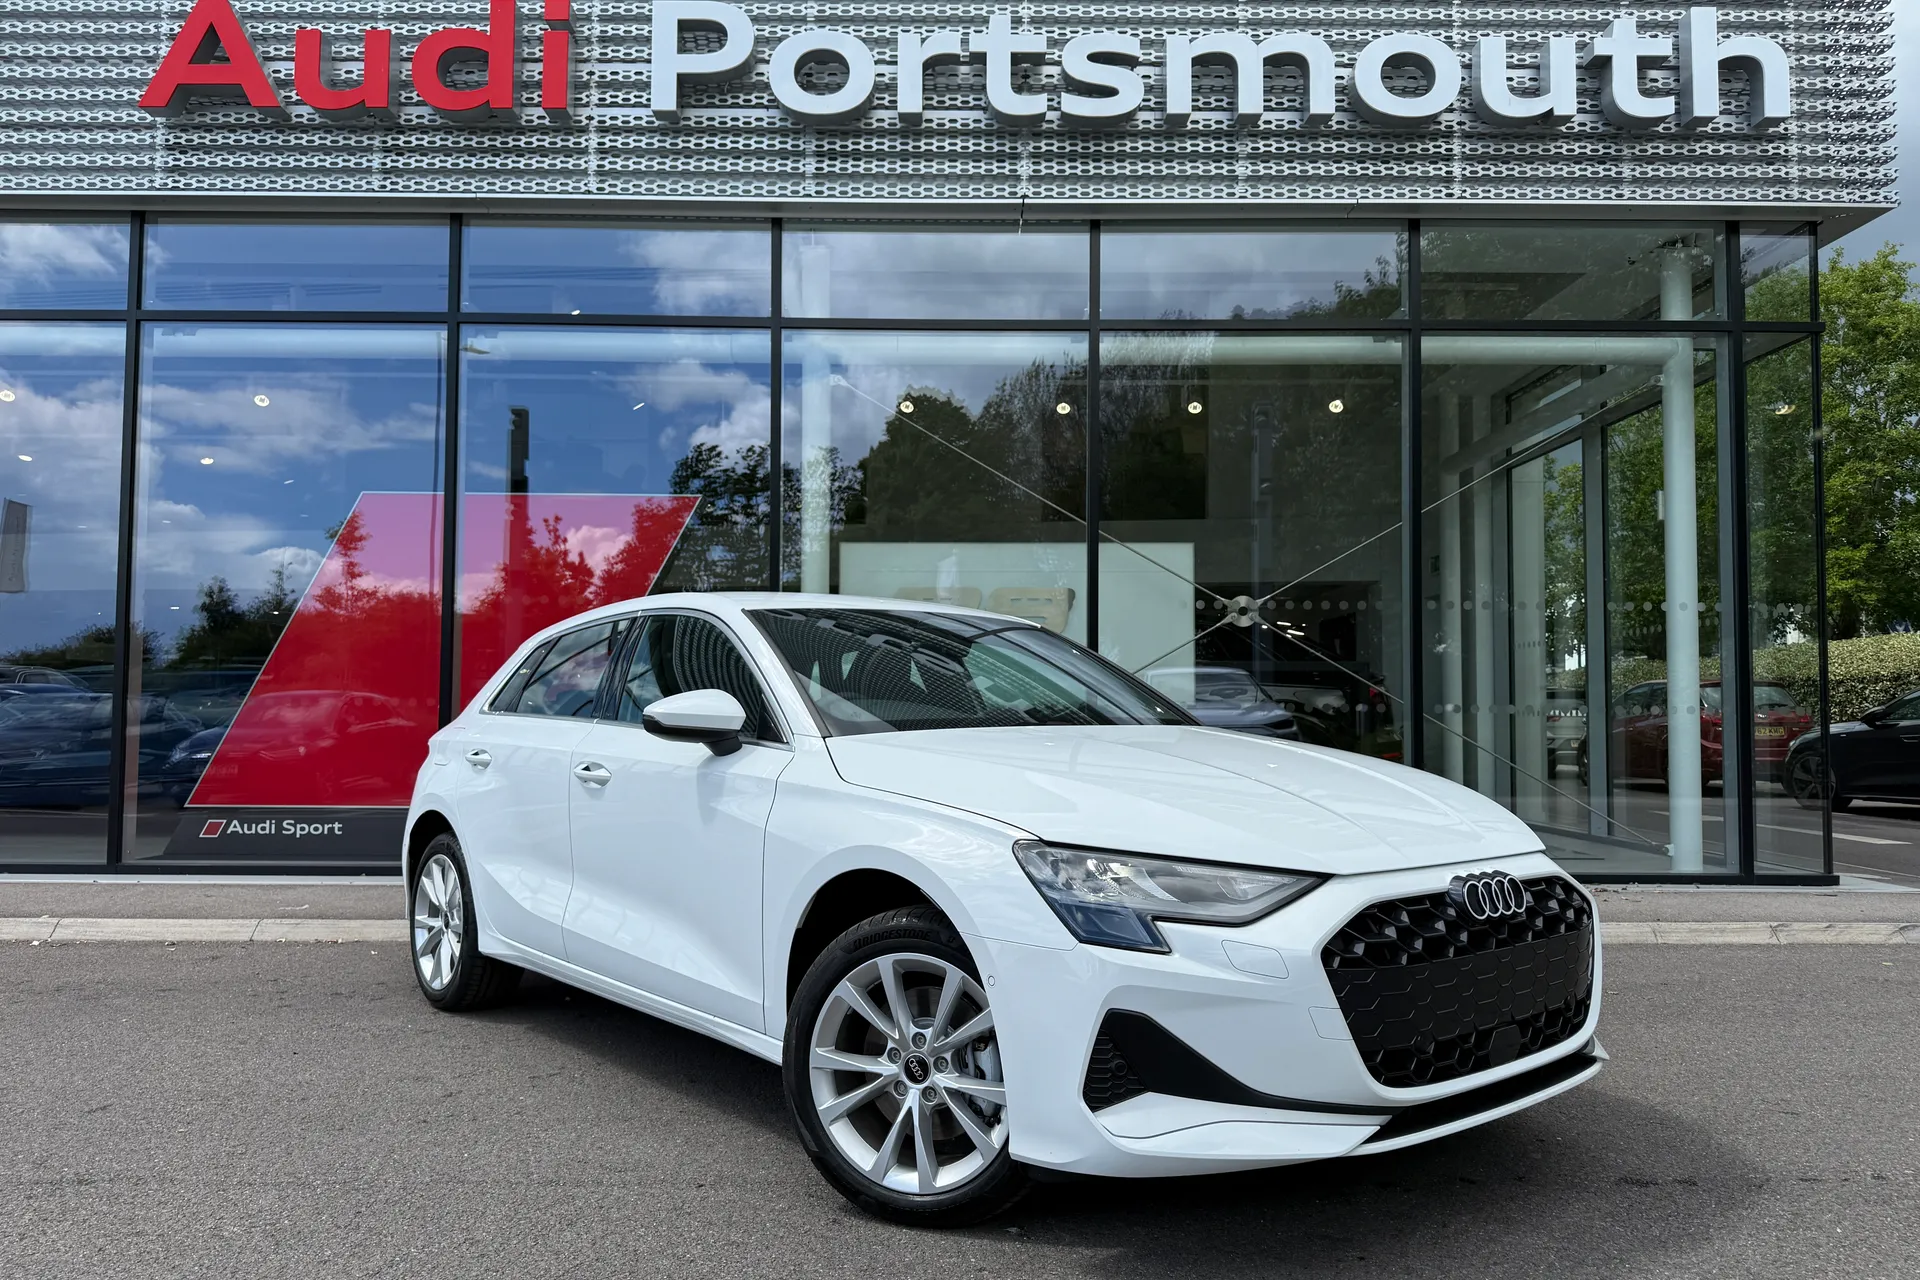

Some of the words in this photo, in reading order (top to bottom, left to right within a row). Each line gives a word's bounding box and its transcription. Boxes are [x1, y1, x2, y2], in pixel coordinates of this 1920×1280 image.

[139, 0, 571, 113] Audi
[651, 0, 1790, 121] Portsmouth
[227, 819, 276, 835] Audi
[282, 819, 343, 839] Sport
[853, 928, 931, 952] BRIDGESTONE
